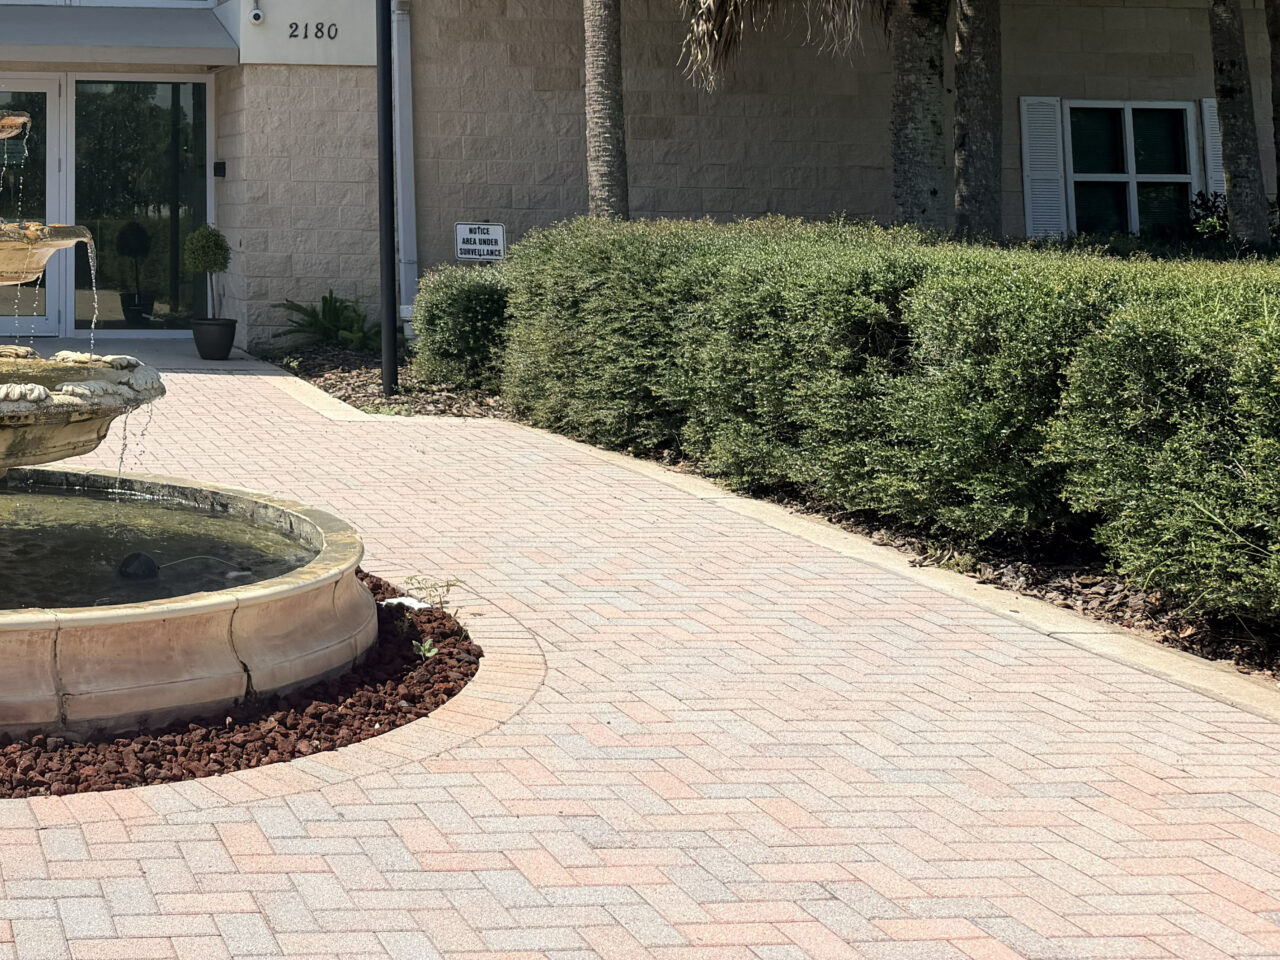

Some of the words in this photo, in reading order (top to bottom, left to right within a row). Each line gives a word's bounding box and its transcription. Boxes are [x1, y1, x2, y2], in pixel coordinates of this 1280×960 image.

[288, 22, 338, 40] 2180
[469, 226, 490, 235] NOTICE
[462, 237, 477, 245] AREA
[478, 238, 498, 246] UNDER
[459, 248, 502, 257] SURVEILLANCE
